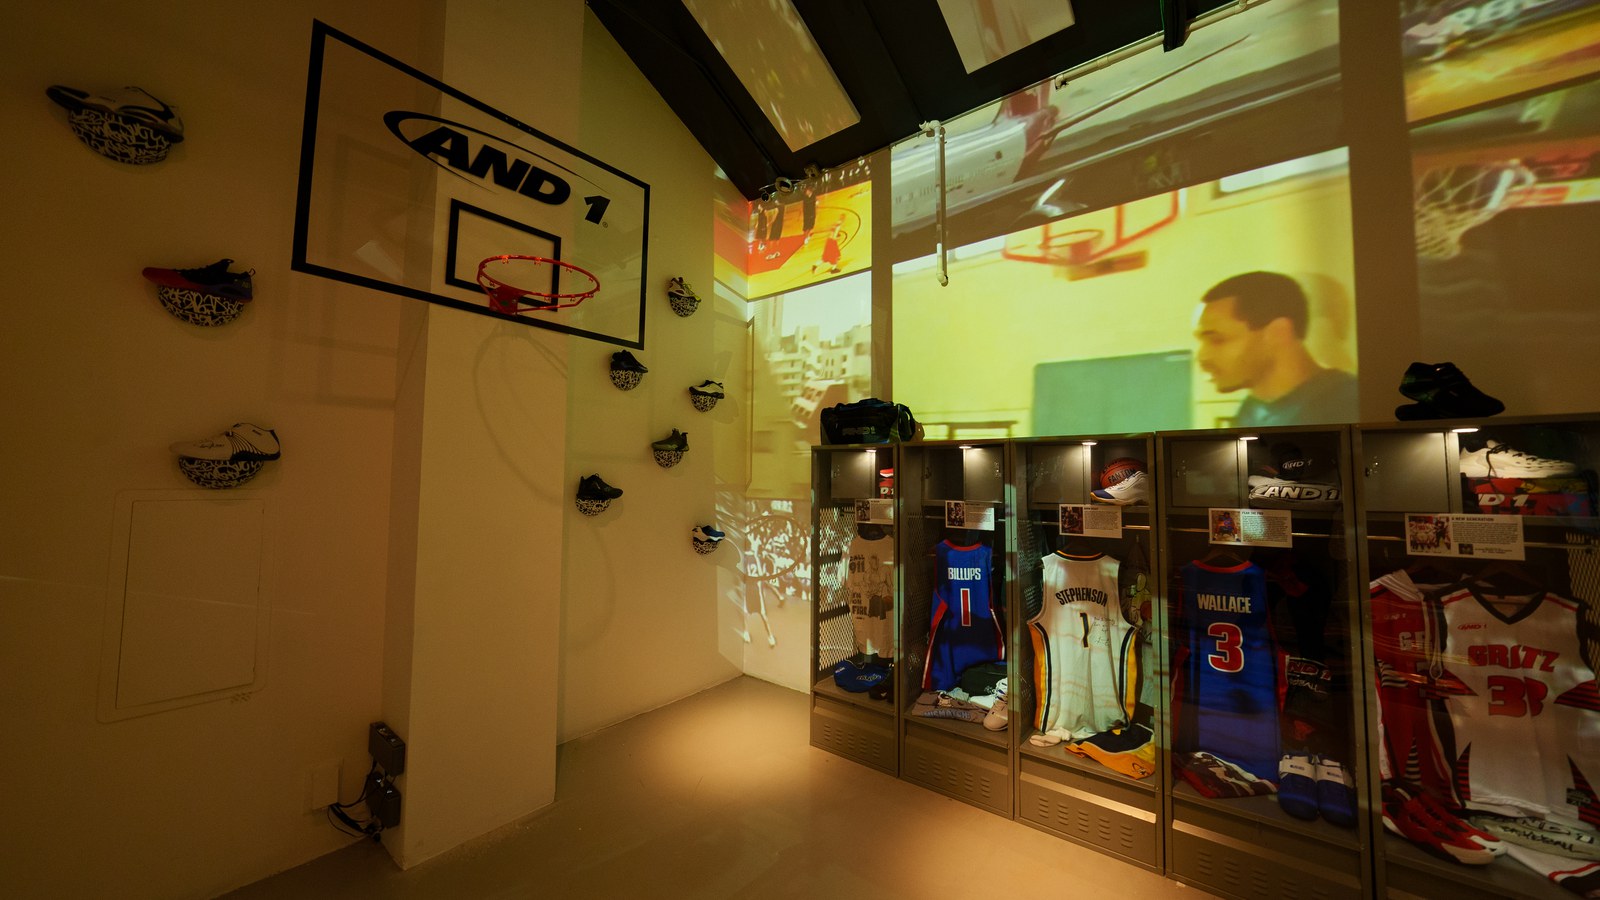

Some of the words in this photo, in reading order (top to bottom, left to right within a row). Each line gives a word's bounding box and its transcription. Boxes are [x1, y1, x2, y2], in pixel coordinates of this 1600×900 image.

[409, 126, 571, 206] AND
[584, 195, 611, 225] 1
[1261, 486, 1321, 500] AND
[1325, 489, 1339, 500] 1
[1478, 494, 1505, 506] D
[947, 567, 982, 581] BILLUPS
[960, 588, 972, 627] 1
[1055, 587, 1108, 607] STEPHENSON
[1196, 593, 1252, 614] WALLACE
[1080, 612, 1089, 648] 1
[1207, 622, 1244, 673] 3
[1468, 644, 1560, 672] GRITZ
